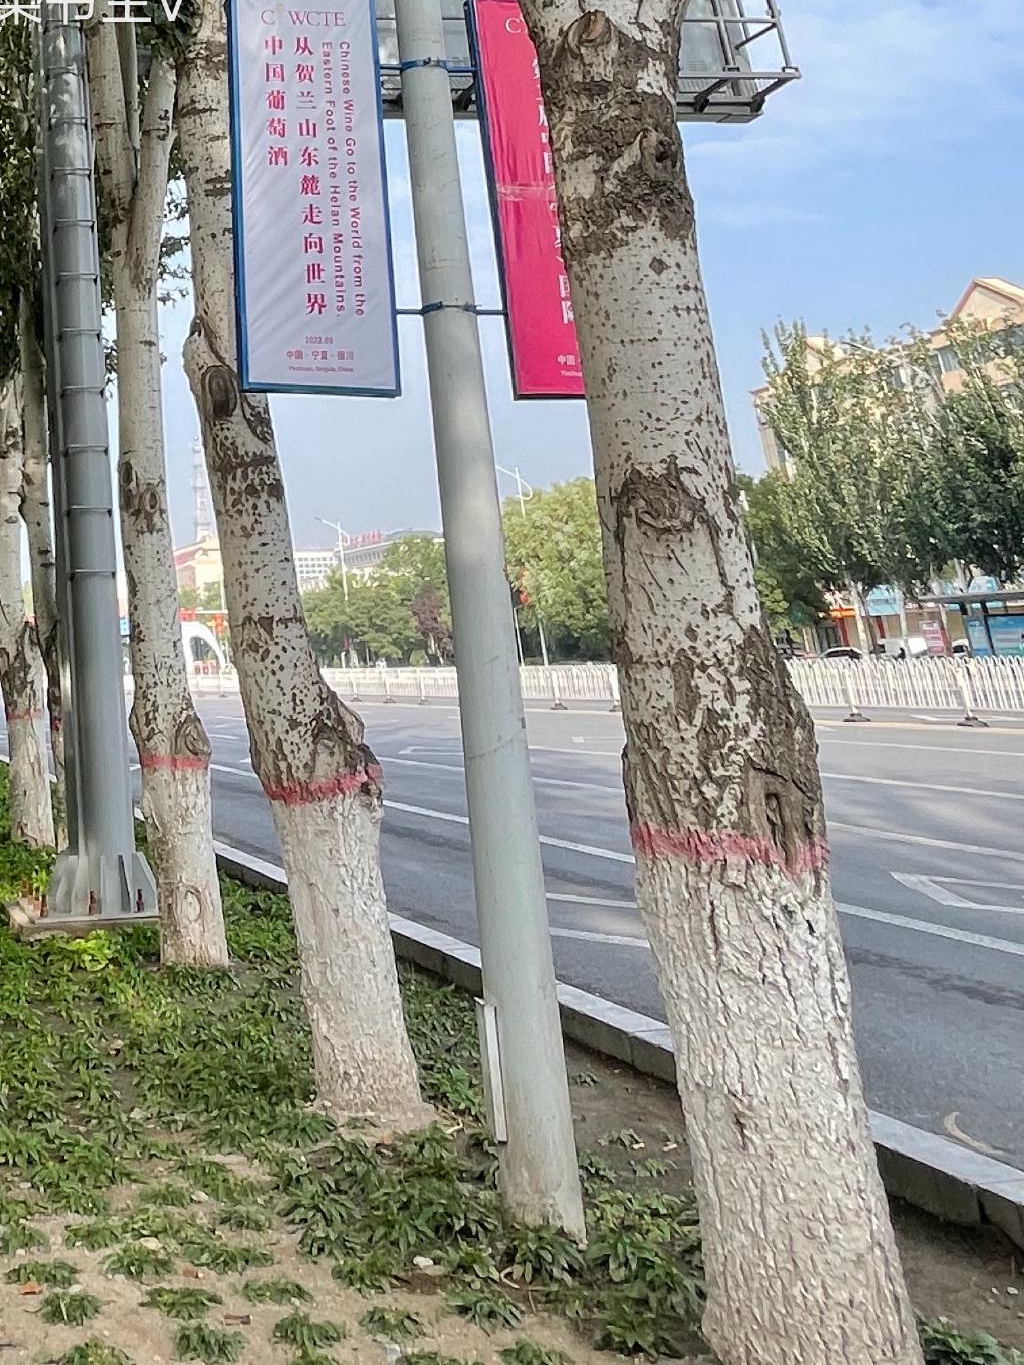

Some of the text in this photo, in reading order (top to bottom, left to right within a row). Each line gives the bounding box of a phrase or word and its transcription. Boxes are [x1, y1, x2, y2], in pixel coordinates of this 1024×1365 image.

[322, 42, 333, 94] Eastern
[264, 35, 288, 166] 中国葡萄酒
[325, 100, 336, 131] Foot
[327, 137, 338, 150] of
[295, 36, 327, 315] 从贺兰山东麓走向世界
[328, 157, 338, 179] the
[339, 41, 366, 316] Chinese Wine Go to the World from the
[330, 185, 341, 226] Helan
